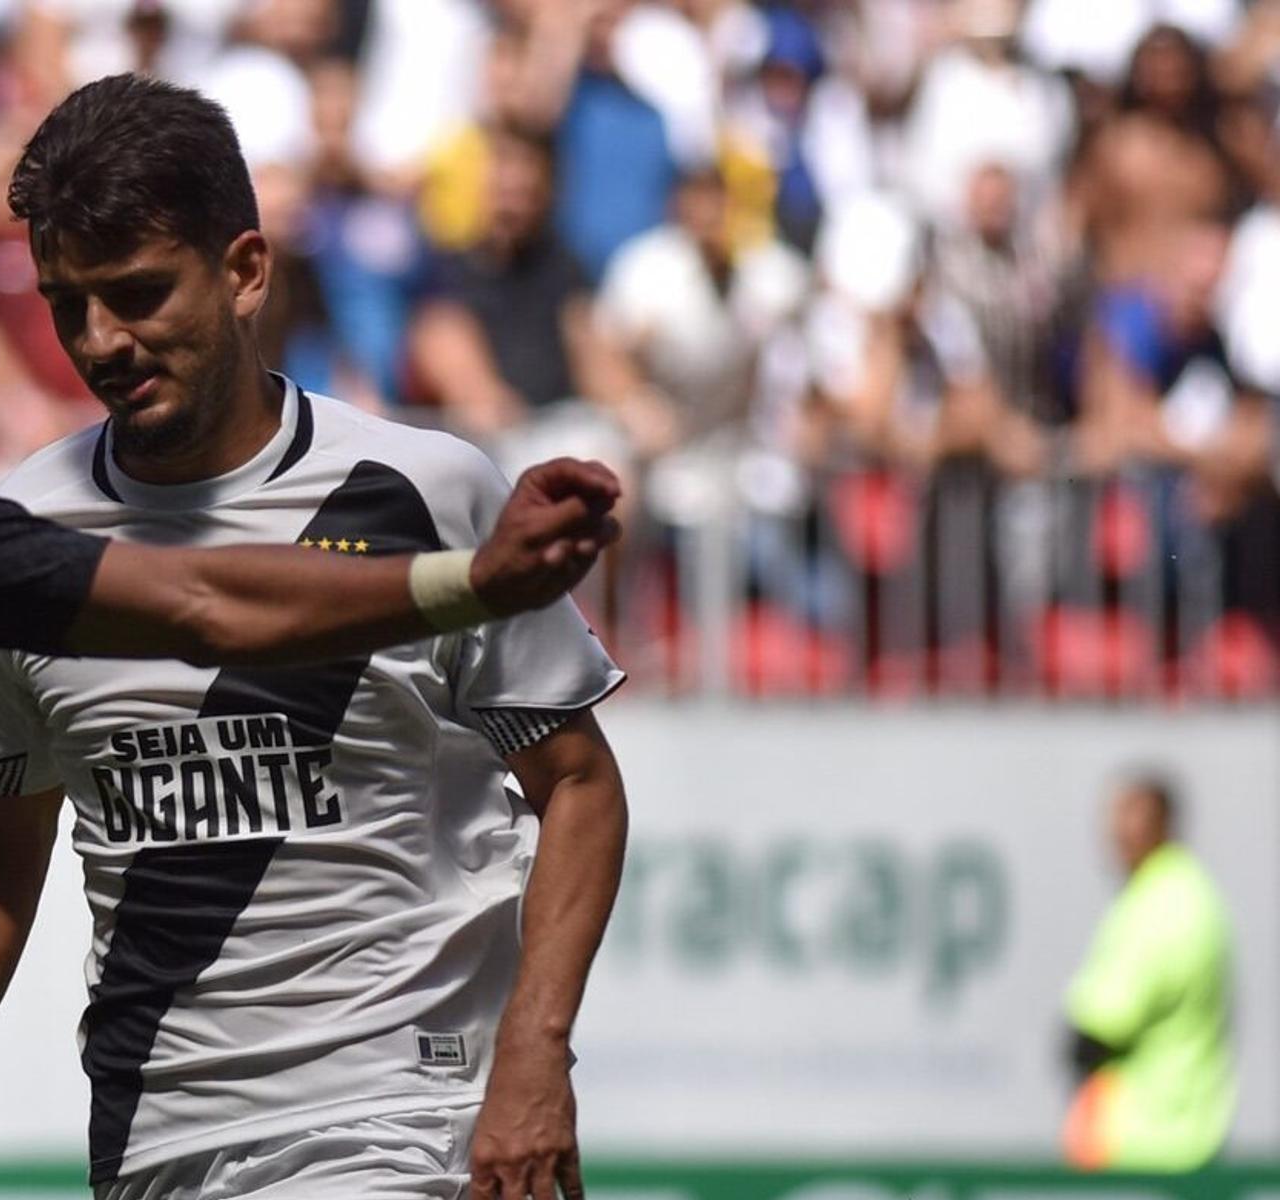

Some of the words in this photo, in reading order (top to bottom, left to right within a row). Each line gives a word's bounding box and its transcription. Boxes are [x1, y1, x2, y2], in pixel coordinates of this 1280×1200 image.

[217, 717, 287, 750] UM
[92, 748, 342, 842] GIGANTE
[610, 835, 1012, 1015] racap
